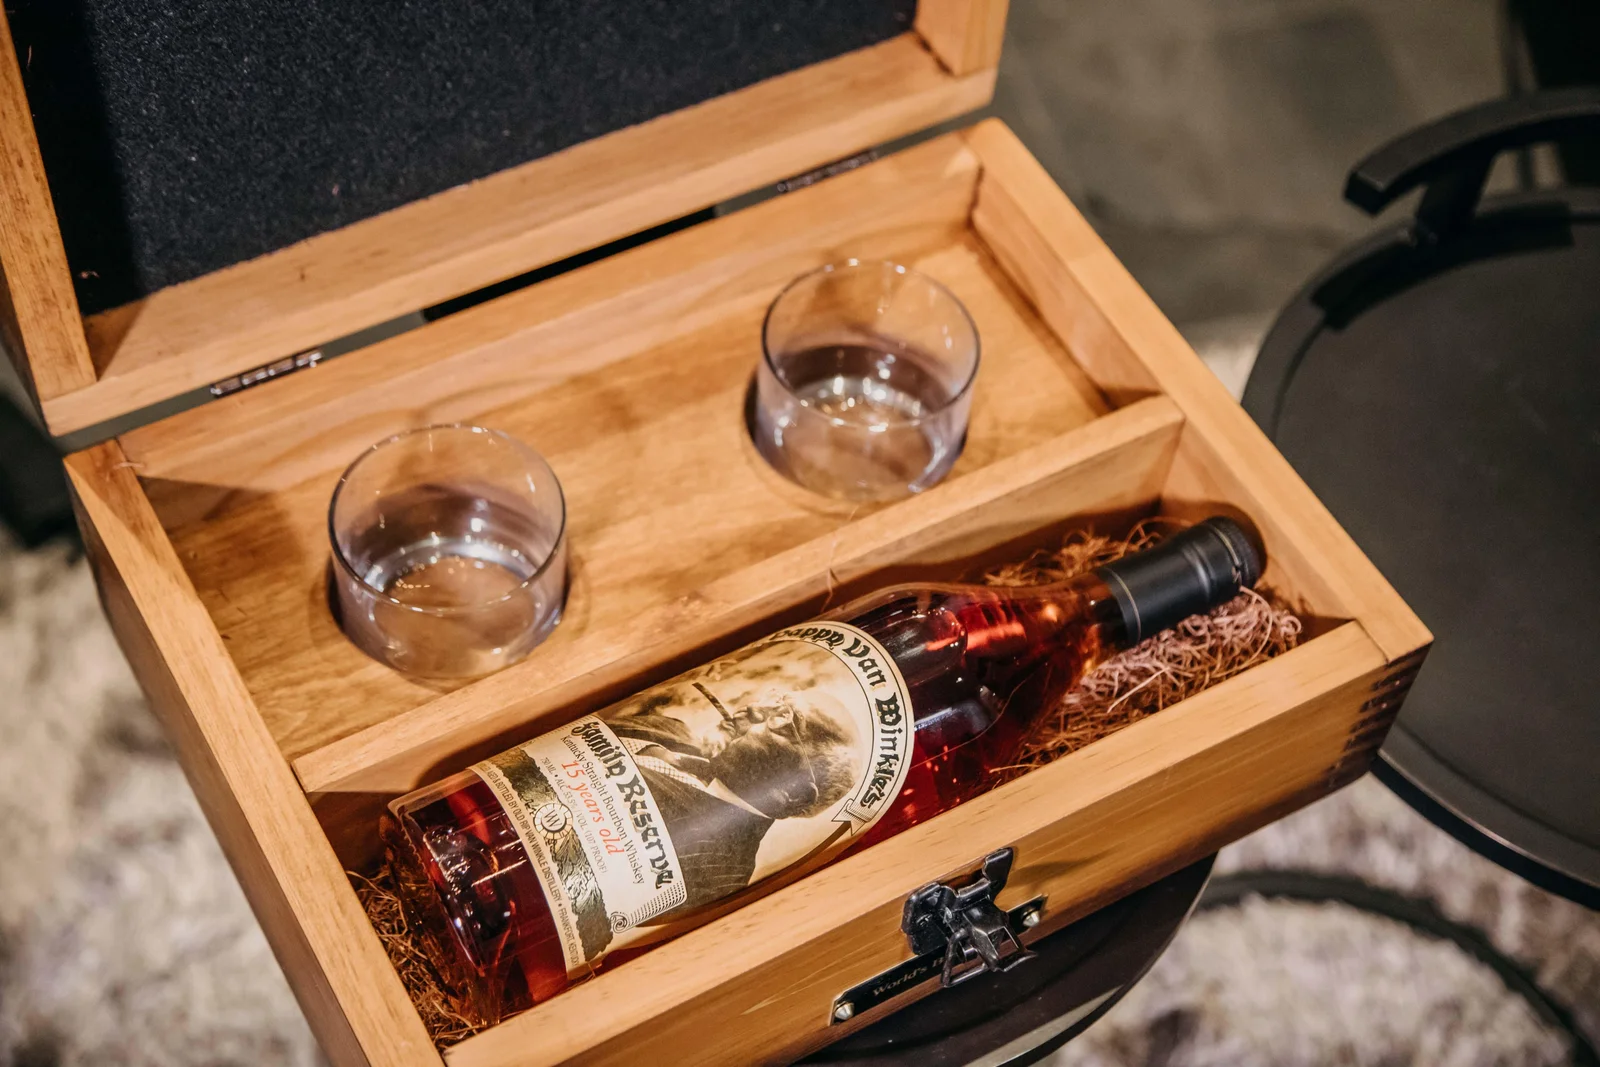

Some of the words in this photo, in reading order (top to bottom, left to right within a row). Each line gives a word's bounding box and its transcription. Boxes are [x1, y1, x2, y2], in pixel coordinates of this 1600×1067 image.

[843, 637, 886, 688] Van
[561, 760, 586, 779] 15
[861, 692, 903, 809] Winkle's
[561, 735, 586, 765] Kentucky
[582, 761, 608, 797] Straight
[603, 795, 626, 840] Bourbon
[624, 839, 645, 885] Whiskey
[568, 782, 605, 823] years
[572, 721, 627, 779] Family
[616, 774, 673, 889] Reserve
[495, 780, 514, 803] BOTTLED
[508, 800, 518, 809] BY
[513, 809, 525, 821] OLD
[519, 819, 531, 830] RIP
[525, 830, 537, 845] VAN
[531, 843, 548, 868] WINKLE
[542, 865, 561, 902] DISTILLERY
[599, 828, 625, 856] old
[873, 966, 927, 996] World's
